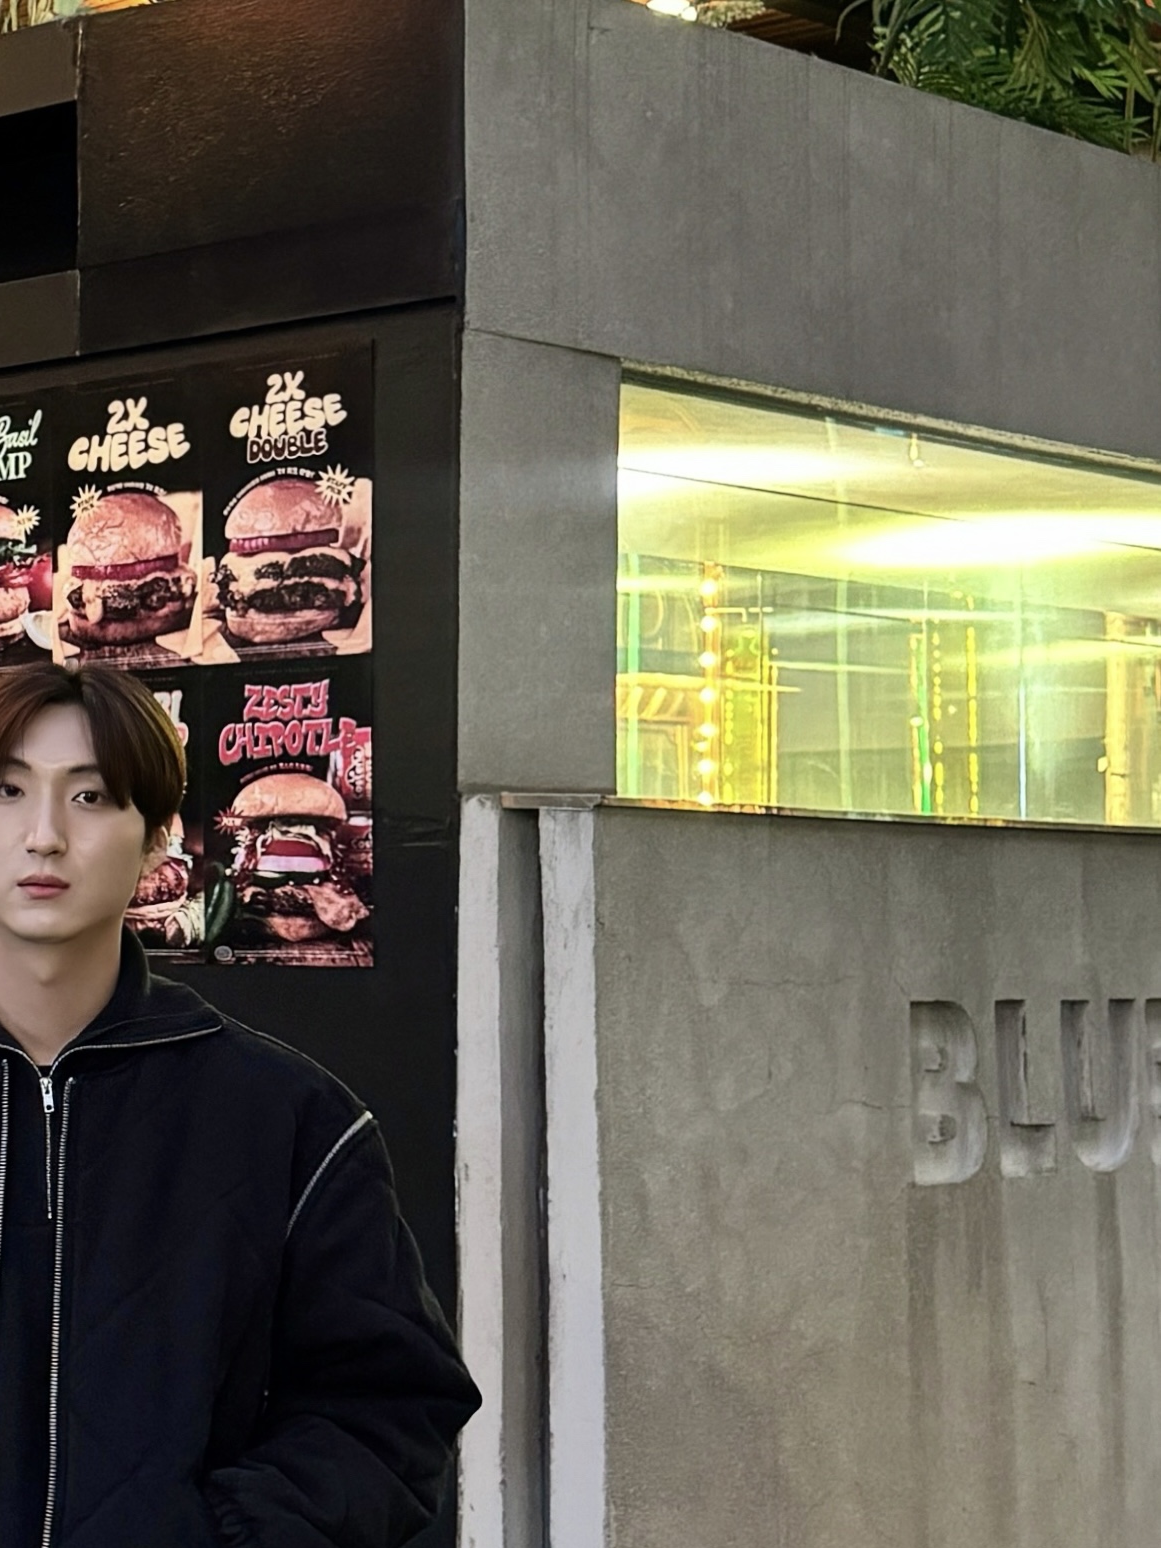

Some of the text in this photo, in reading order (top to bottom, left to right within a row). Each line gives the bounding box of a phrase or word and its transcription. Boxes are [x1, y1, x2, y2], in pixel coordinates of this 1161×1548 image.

[265, 370, 306, 404] 2X
[106, 396, 150, 434] 2X
[229, 393, 348, 438] CHEESE
[67, 422, 191, 473] CHEESE
[247, 428, 329, 464] DOUBLE
[243, 678, 331, 722] ZESTY
[909, 998, 1161, 1185] BLU
